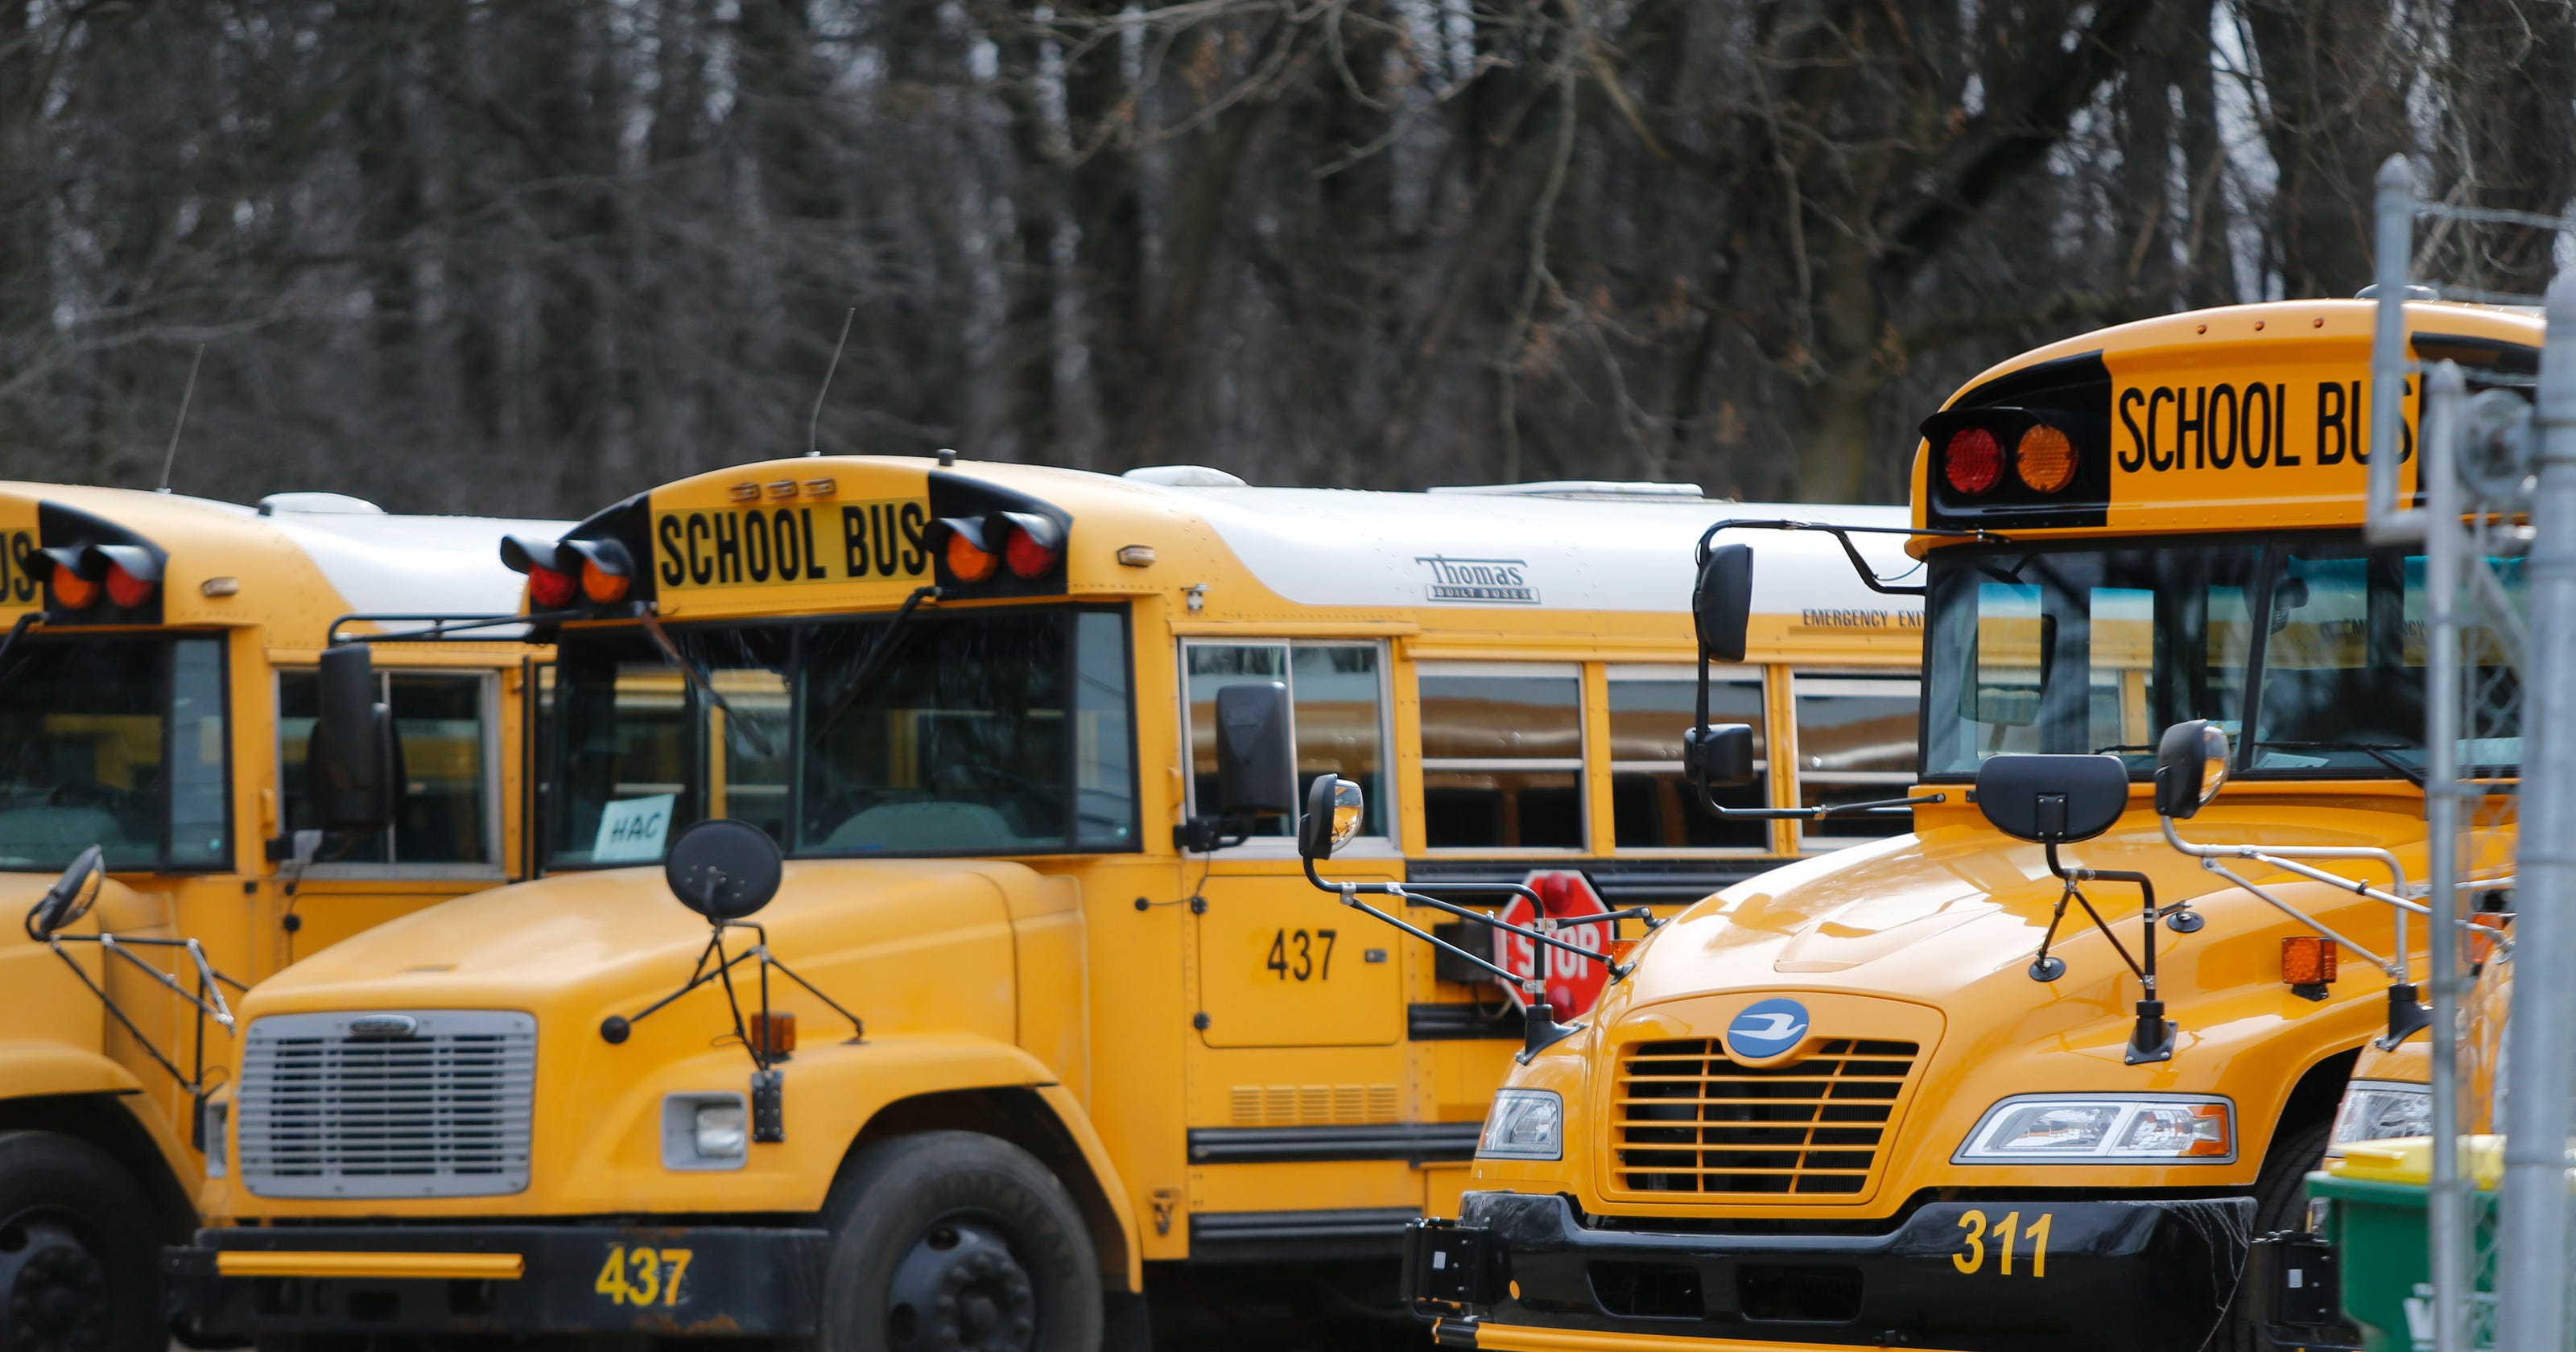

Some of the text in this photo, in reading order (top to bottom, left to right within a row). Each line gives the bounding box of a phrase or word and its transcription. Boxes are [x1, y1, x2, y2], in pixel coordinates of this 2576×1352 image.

[2118, 381, 2301, 473] SCHOOL
[659, 502, 928, 587] SCHOOL BUS
[1414, 554, 1528, 586] Thomas
[1435, 587, 1529, 600] BUILT BUSES
[1802, 608, 1926, 628] EMERGENCY EXI
[1267, 928, 1338, 982] 437
[1952, 1209, 2053, 1278] 311
[596, 1246, 693, 1307] 437
